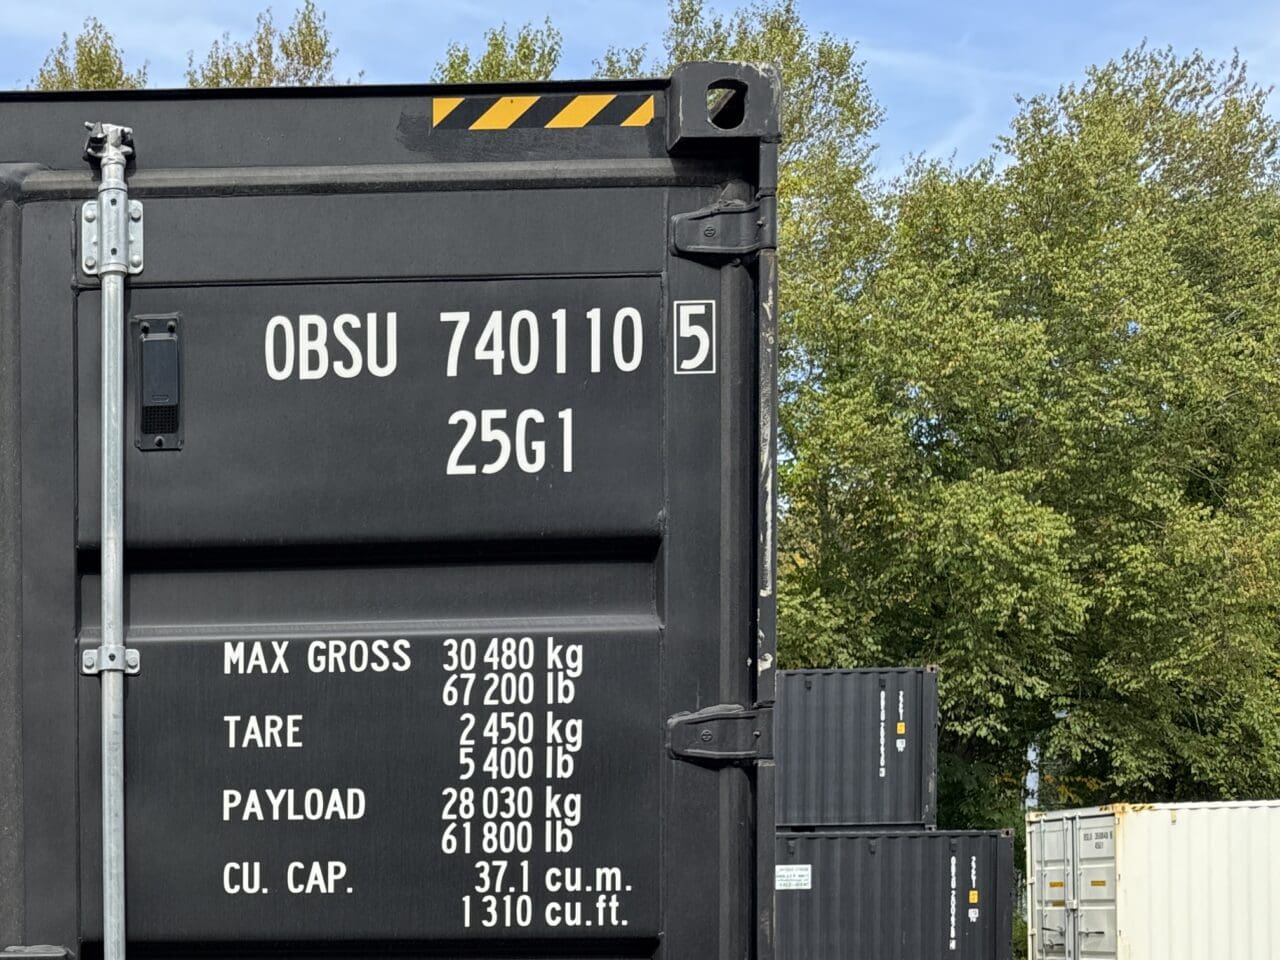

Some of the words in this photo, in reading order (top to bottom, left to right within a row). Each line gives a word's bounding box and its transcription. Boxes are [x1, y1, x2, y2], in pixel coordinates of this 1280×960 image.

[264, 311, 397, 381] OBSU
[439, 306, 643, 377] 740110
[679, 304, 711, 370] 5
[446, 407, 573, 475] 25G1
[223, 640, 290, 674] MAX
[307, 638, 411, 673] GROSS
[547, 636, 584, 678] kg
[546, 671, 576, 705] lb
[223, 714, 303, 748] TARE
[546, 711, 584, 752] kg
[545, 745, 575, 779] lb
[222, 788, 366, 821] PAYLOAD
[545, 785, 582, 826] kg
[545, 820, 574, 853] lb
[223, 861, 268, 894] CU.
[287, 860, 353, 894] CAP.
[474, 859, 529, 893] 37.1
[545, 867, 632, 892] cu.m.
[544, 893, 628, 927] cu.ft.
